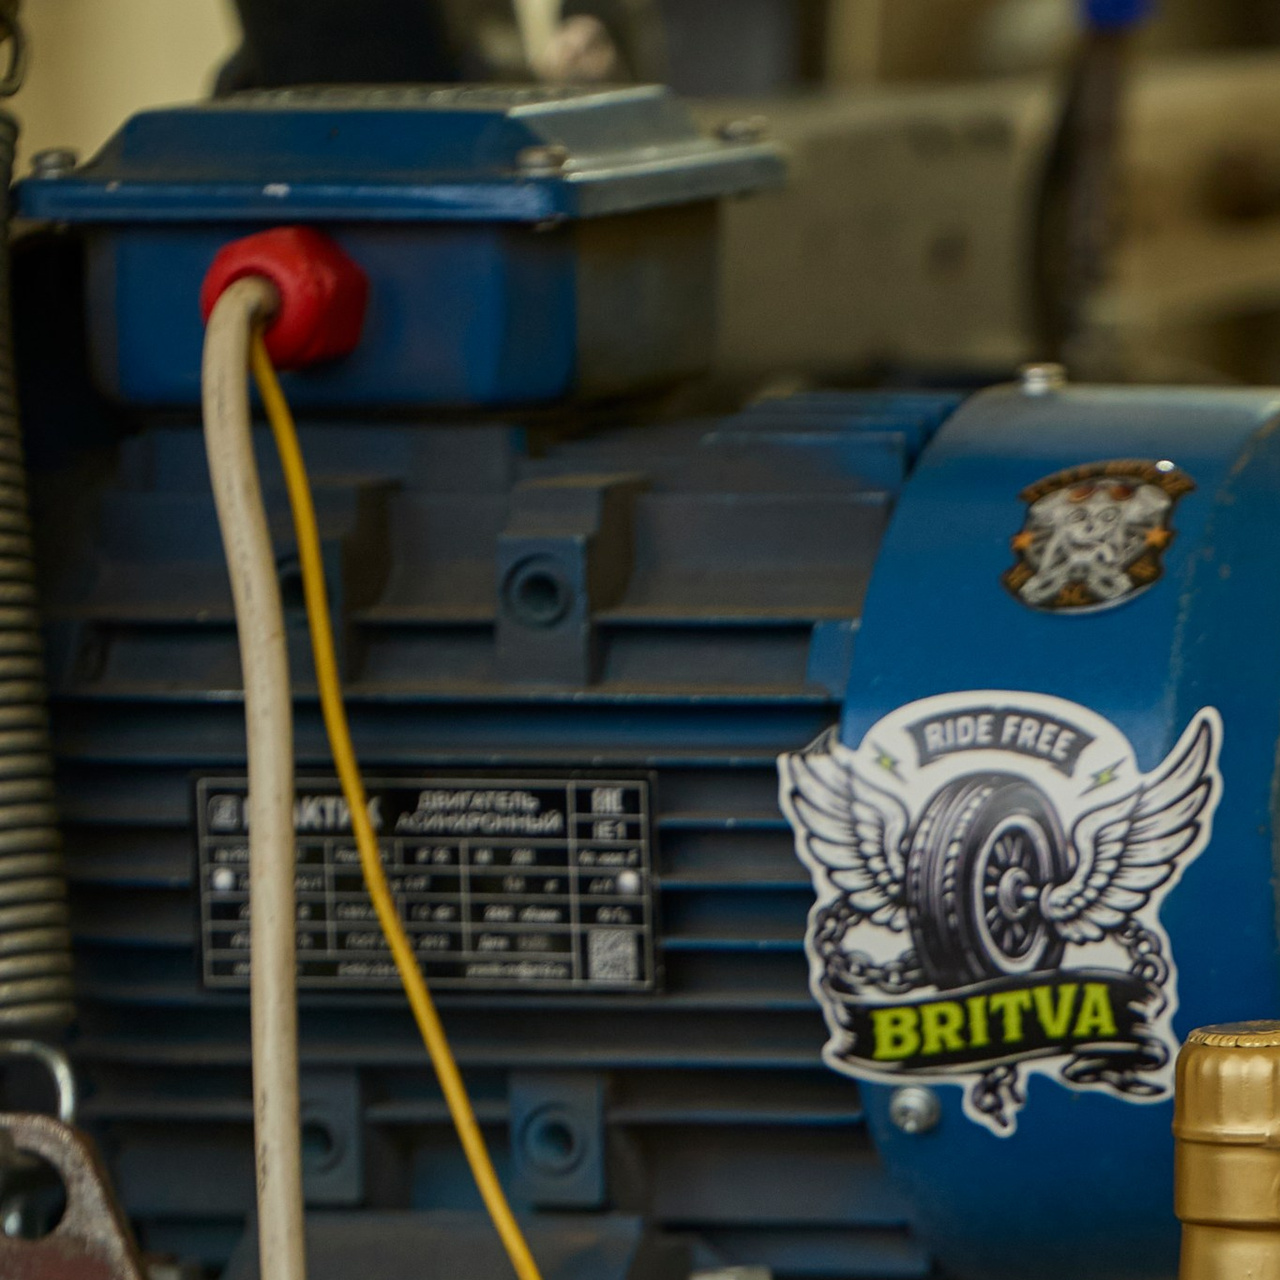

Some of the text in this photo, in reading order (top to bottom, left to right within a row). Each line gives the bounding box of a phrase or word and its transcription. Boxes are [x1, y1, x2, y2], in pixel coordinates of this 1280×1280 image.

[924, 714, 1078, 762] RIDE FREE
[871, 982, 1118, 1061] BRITVA
